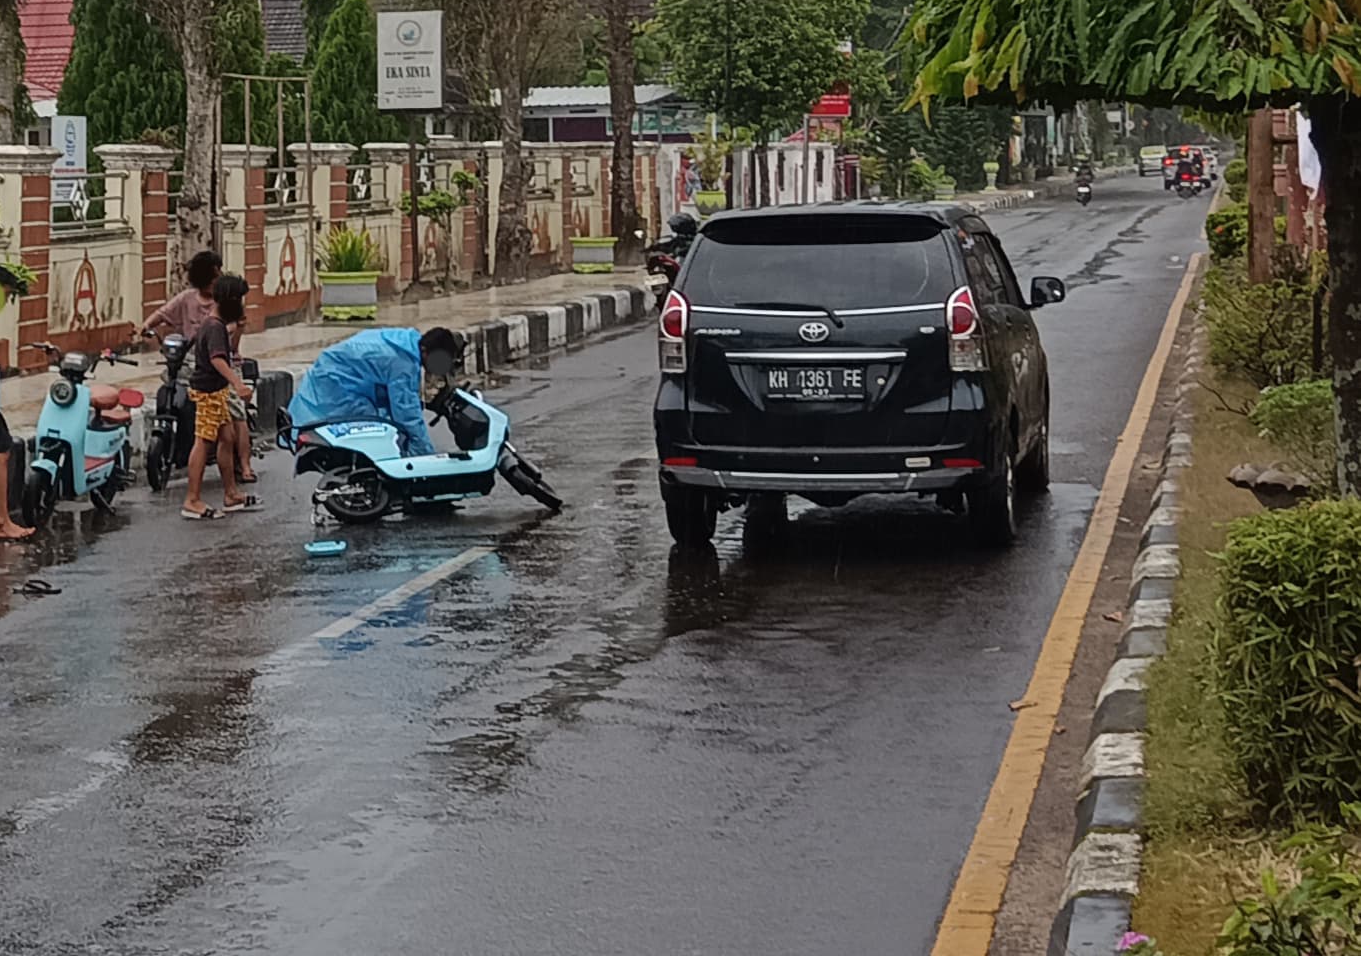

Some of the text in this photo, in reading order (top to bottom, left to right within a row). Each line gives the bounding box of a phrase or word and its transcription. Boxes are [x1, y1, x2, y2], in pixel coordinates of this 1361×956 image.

[768, 369, 863, 388] KH 1361 FE
